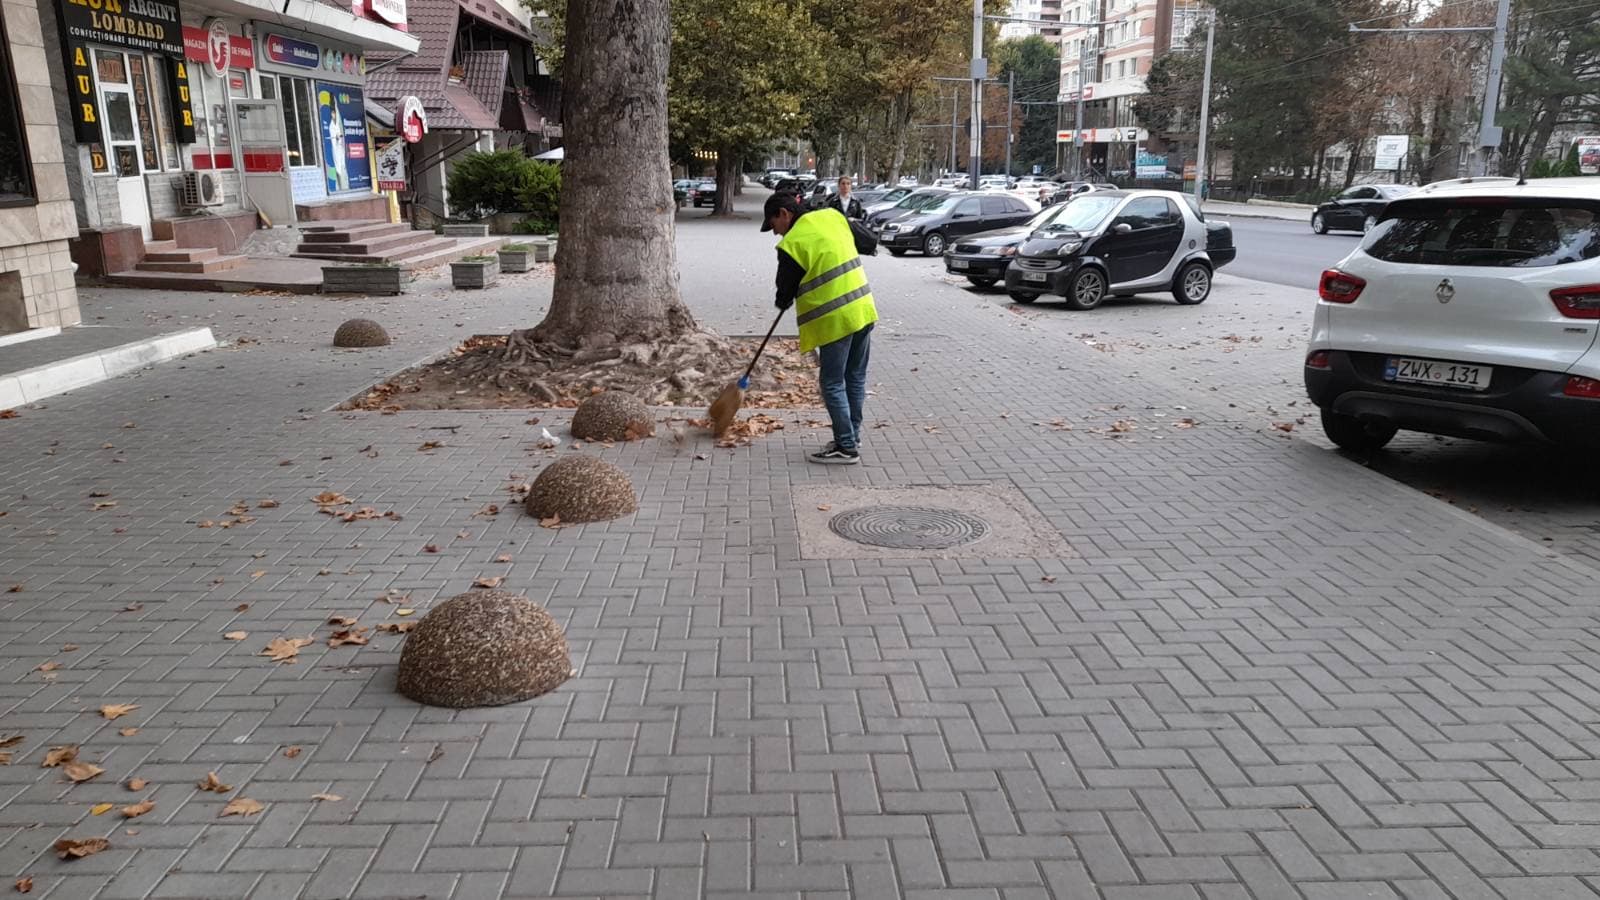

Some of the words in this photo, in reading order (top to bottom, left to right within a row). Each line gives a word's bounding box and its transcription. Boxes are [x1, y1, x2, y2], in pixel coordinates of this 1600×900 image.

[91, 10, 164, 40] LOMBARD
[128, 0, 177, 22] ARGINT
[74, 47, 96, 123] AUR
[176, 62, 193, 126] AUR
[1399, 360, 1434, 379] ZWX
[1445, 366, 1480, 385] 131
